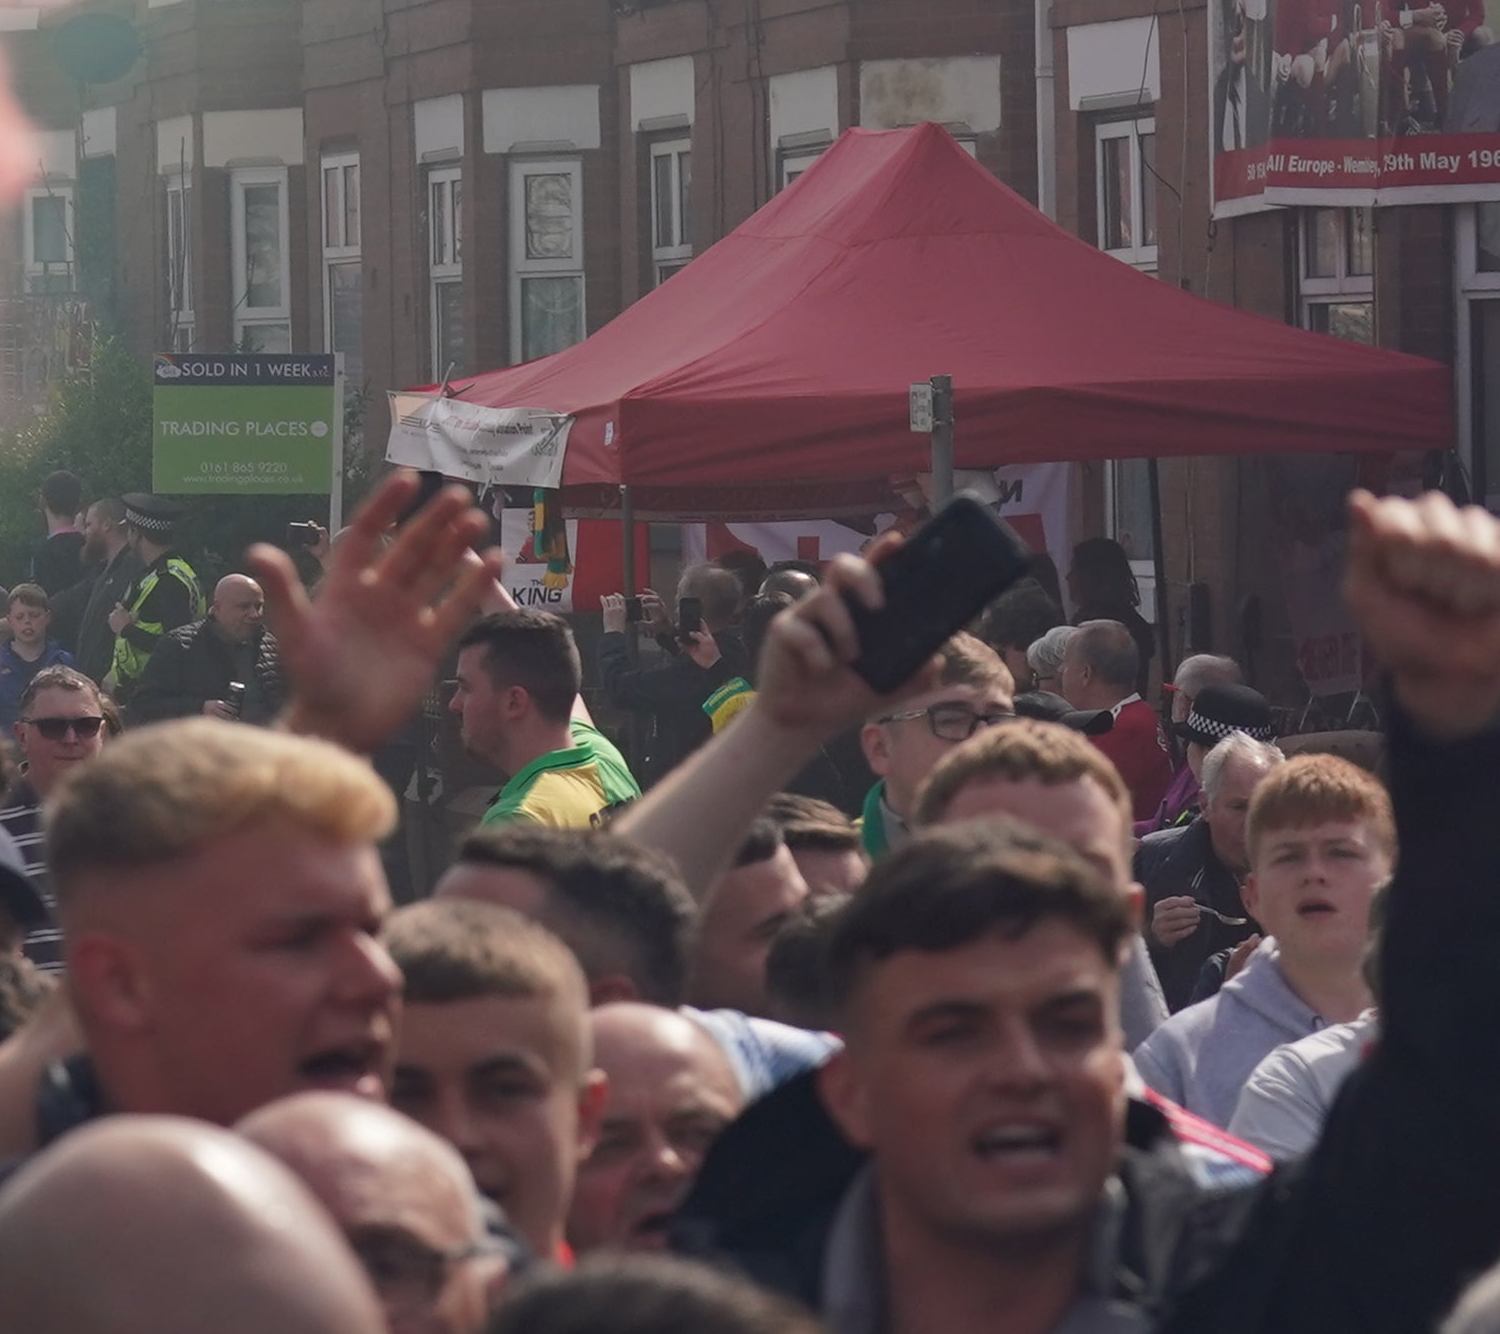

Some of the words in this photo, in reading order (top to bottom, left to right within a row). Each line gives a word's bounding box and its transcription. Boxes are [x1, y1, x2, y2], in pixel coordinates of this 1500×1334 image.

[1266, 155, 1284, 172] All
[1288, 156, 1335, 177] Europe
[1420, 152, 1461, 173] May
[182, 362, 225, 377] SOLD
[230, 363, 247, 377] IN
[255, 363, 260, 376] 1
[268, 362, 311, 377] WEEK
[160, 421, 241, 436] TRADING
[246, 421, 308, 436] PLACES
[201, 462, 228, 473] 0161
[232, 461, 255, 473] 865
[258, 461, 287, 473] 9220
[512, 586, 563, 607] KING
